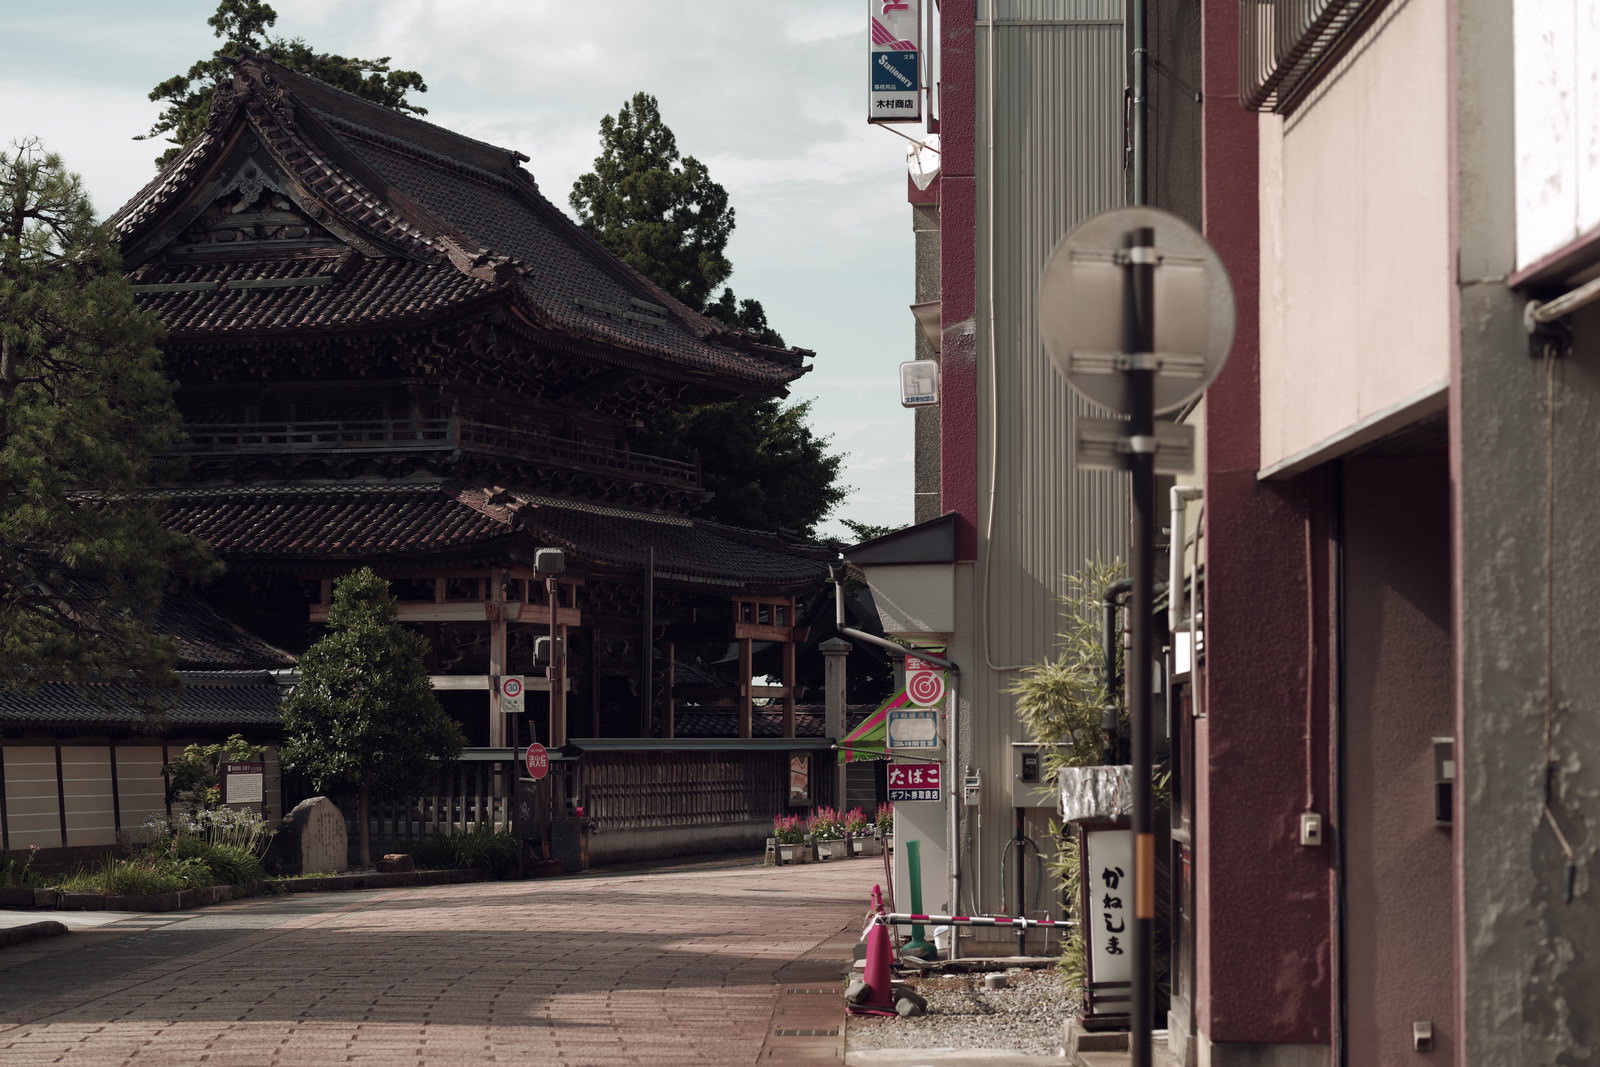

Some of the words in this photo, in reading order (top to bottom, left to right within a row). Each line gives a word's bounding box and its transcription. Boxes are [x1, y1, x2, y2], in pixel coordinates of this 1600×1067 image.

[878, 54, 913, 88] Stationery
[876, 99, 914, 109] 木村商店
[507, 683, 518, 692] 30
[890, 768, 939, 785] たばこ
[1102, 866, 1126, 956] かねしま
